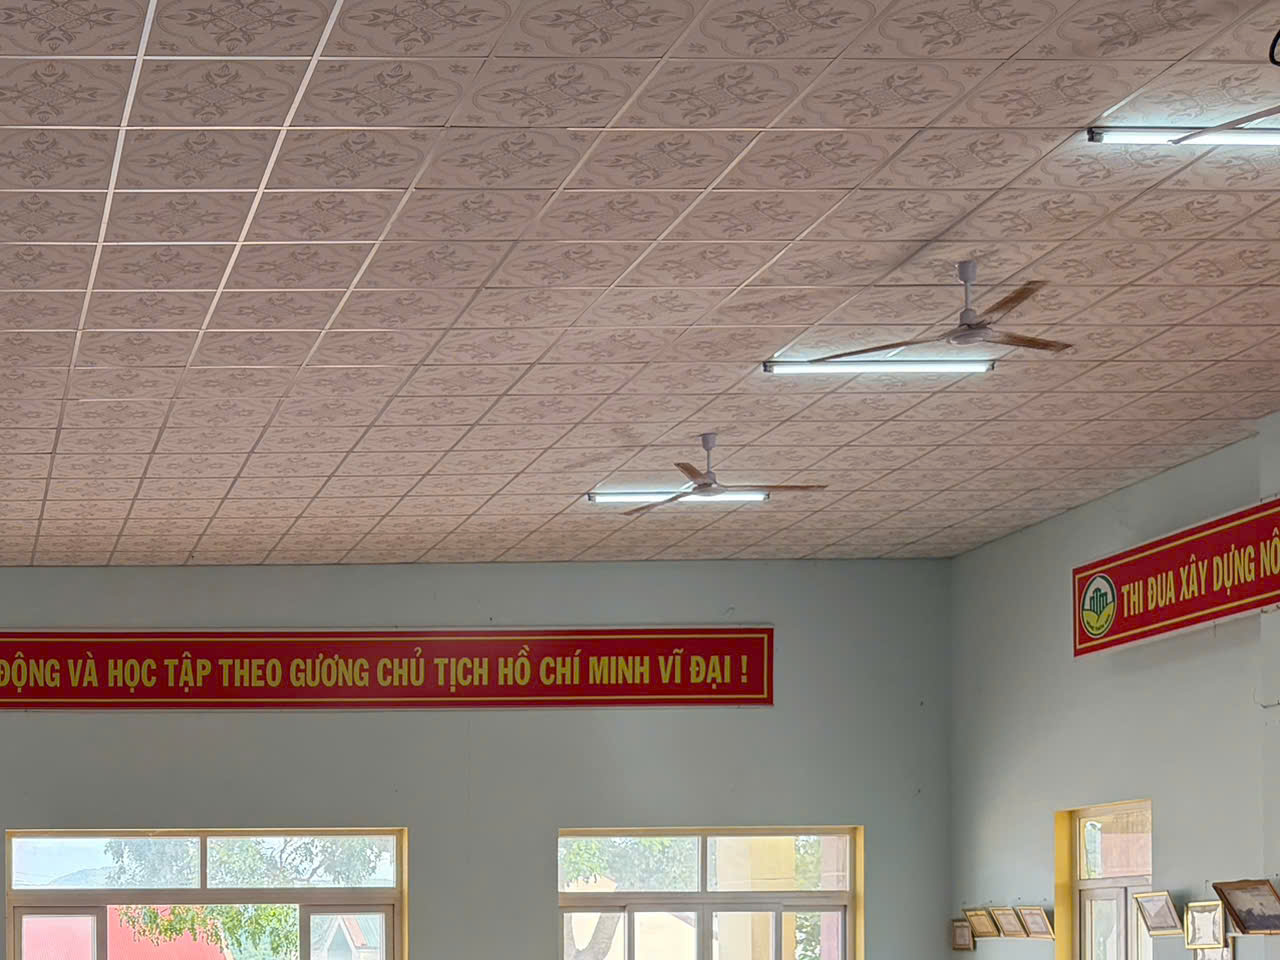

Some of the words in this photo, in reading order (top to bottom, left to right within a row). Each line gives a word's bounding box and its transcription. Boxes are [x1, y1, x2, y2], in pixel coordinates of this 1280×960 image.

[1121, 579, 1144, 618] THI
[1147, 570, 1176, 611] ĐUA
[1179, 554, 1208, 602] XÂY
[1213, 543, 1256, 596] DỰNG
[68, 652, 99, 687] VÀ
[108, 658, 157, 693] HỌC
[164, 652, 212, 693] TẬP
[219, 658, 283, 688] THEO
[289, 654, 370, 687] GƯƠNG
[377, 647, 425, 687] CHỦ
[433, 656, 489, 692] TỊCH
[498, 645, 531, 686] HỒ
[539, 649, 582, 686] CHÍ
[589, 655, 650, 685] MINH
[658, 648, 684, 684] VĨ
[690, 655, 731, 689] ĐẠI
